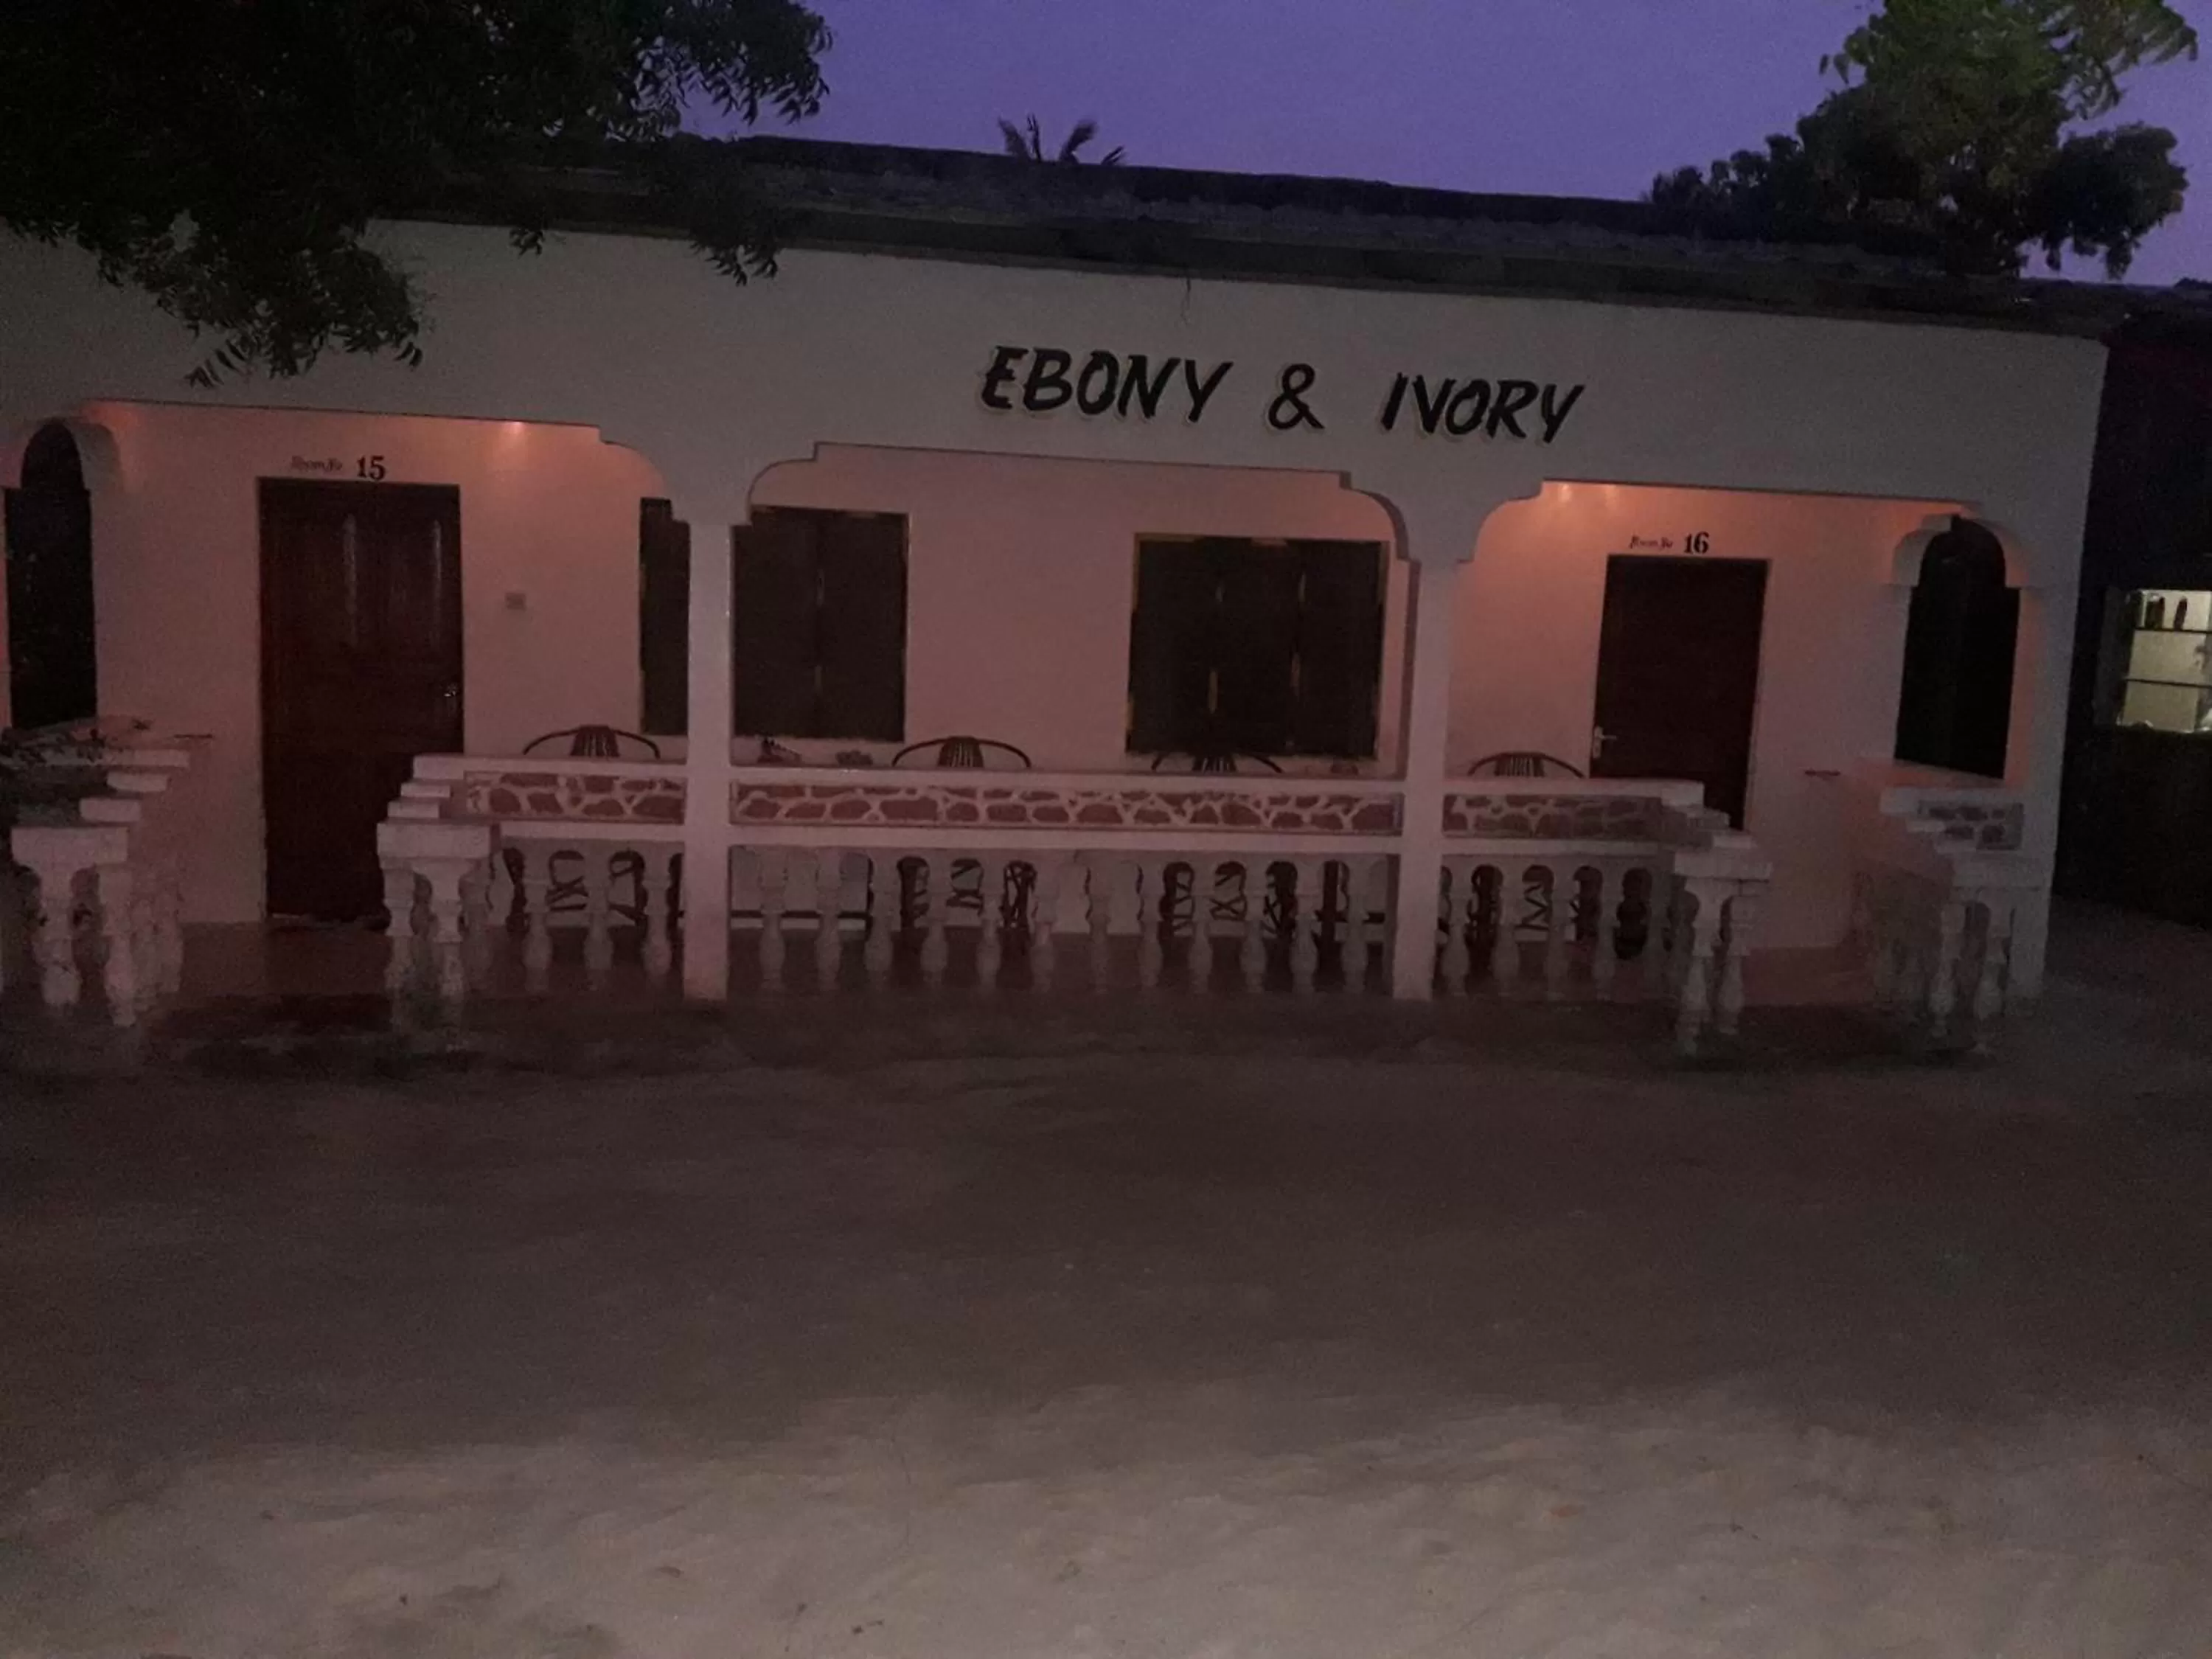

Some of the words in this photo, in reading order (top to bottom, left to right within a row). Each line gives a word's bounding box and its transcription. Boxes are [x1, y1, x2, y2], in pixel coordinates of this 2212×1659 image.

[981, 345, 1233, 422] EBONY
[1268, 364, 1325, 430] &
[1381, 372, 1585, 442] IVORY
[357, 455, 386, 480] 15
[1684, 531, 1710, 554] 16
